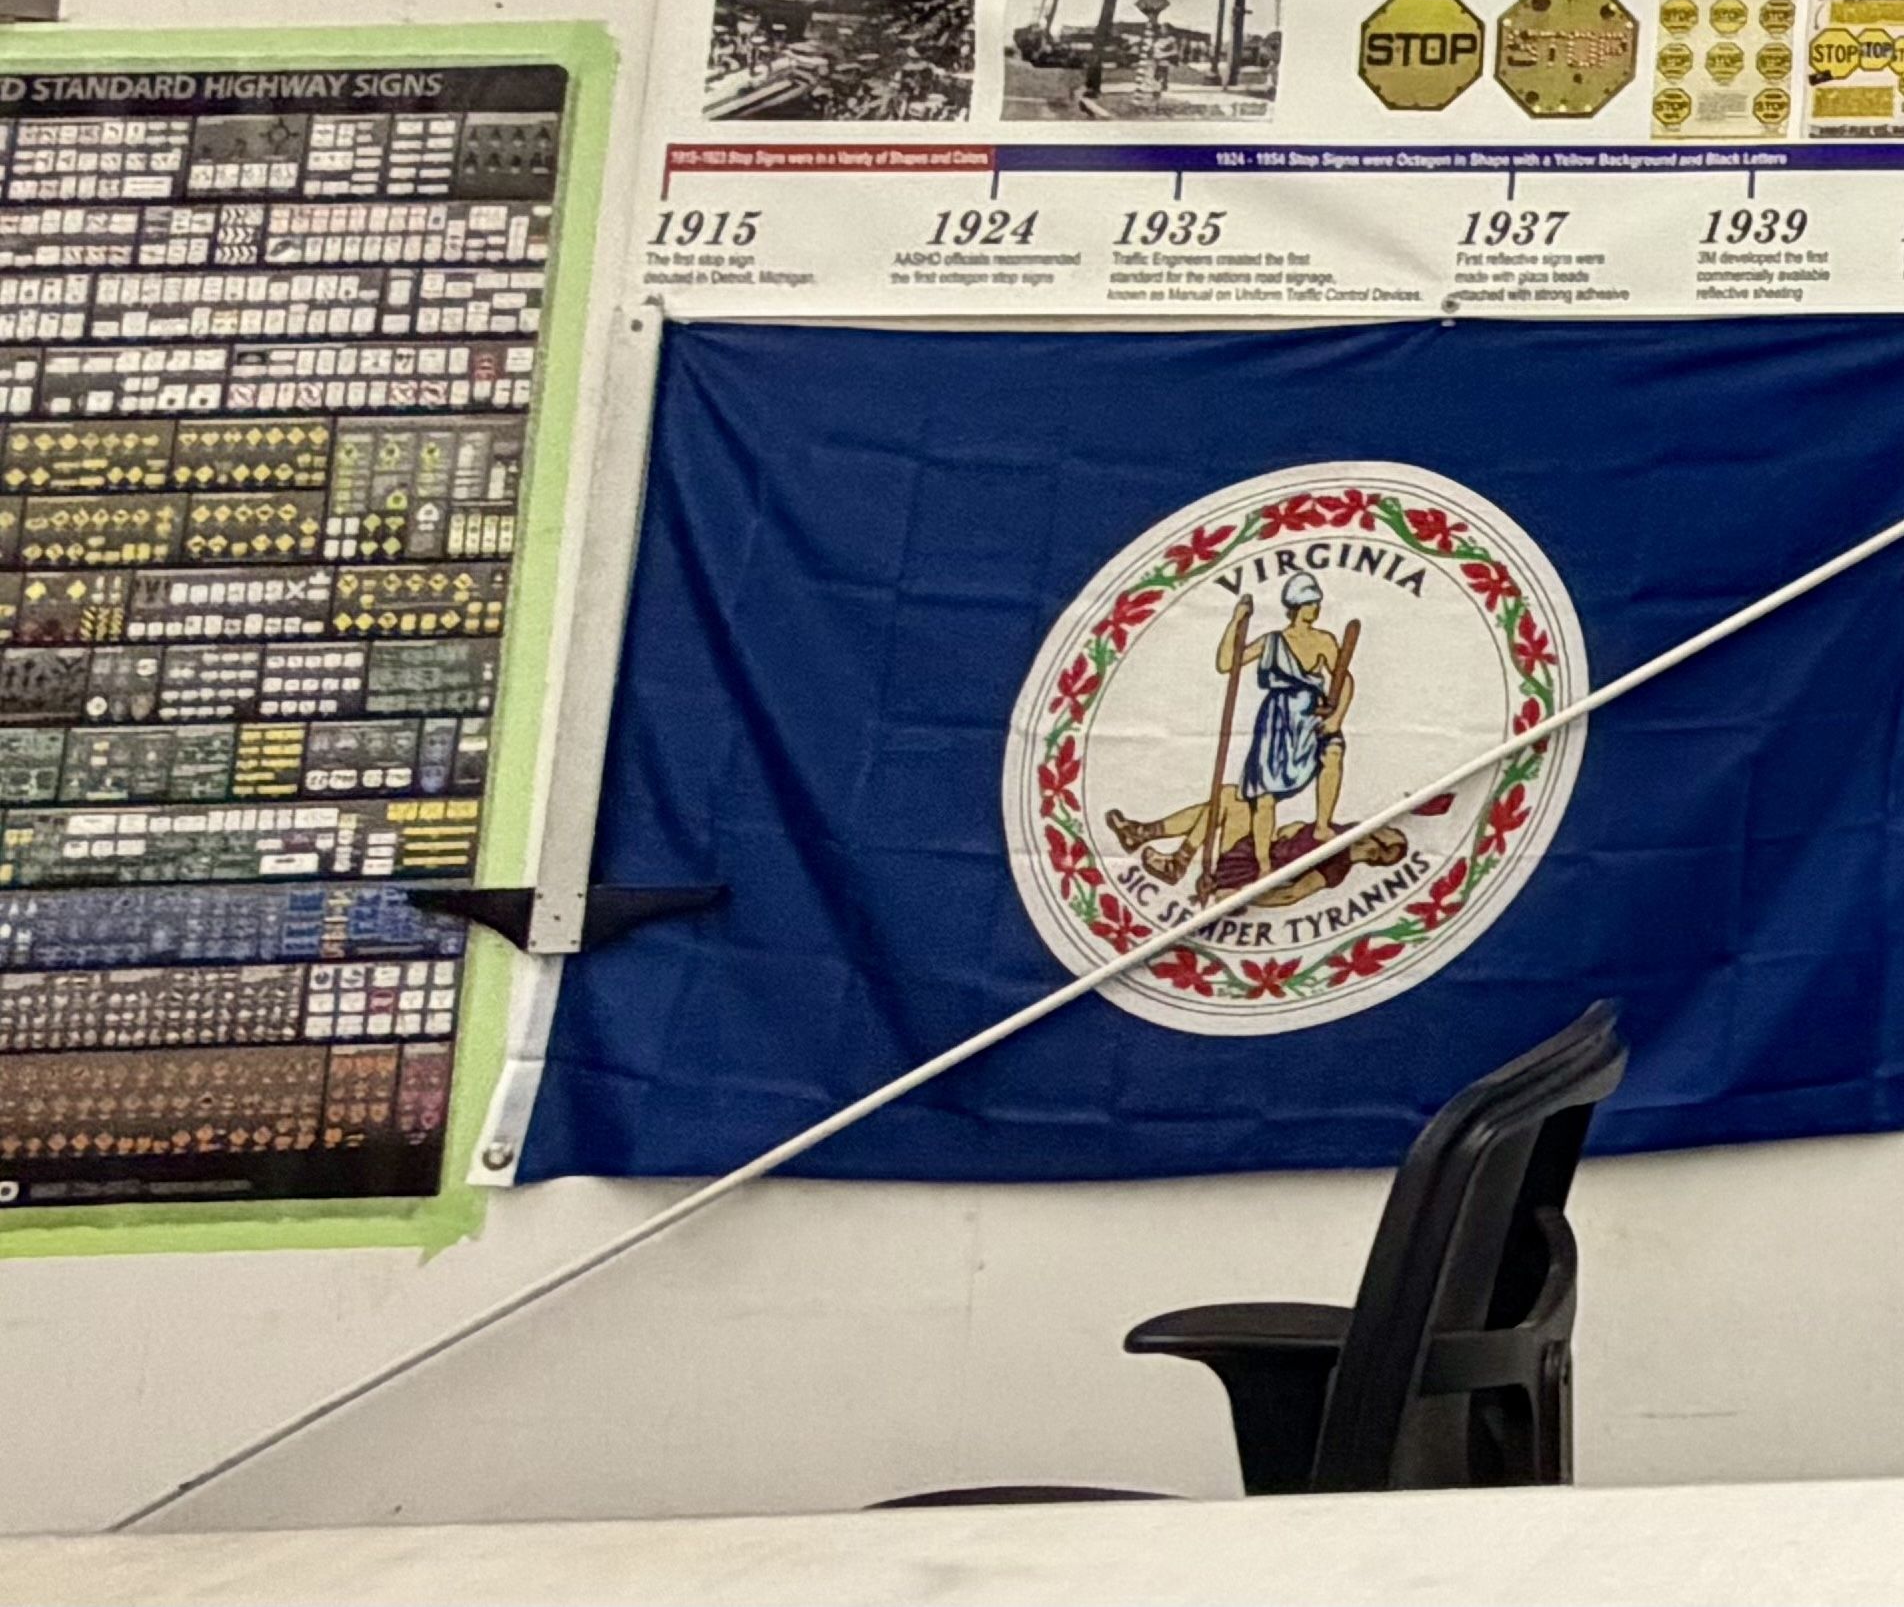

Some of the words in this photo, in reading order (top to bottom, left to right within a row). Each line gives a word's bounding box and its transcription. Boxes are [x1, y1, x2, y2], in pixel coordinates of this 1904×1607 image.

[1366, 33, 1478, 67] STOP
[1507, 30, 1628, 69] STOP
[1812, 44, 1860, 63] STOP
[33, 75, 197, 101] STANDARD
[204, 74, 350, 99] HIGHWAY
[352, 73, 443, 97] SIGNS
[647, 210, 763, 245] 1915
[926, 210, 1039, 245] 1924
[1113, 210, 1227, 245] 1935
[1458, 210, 1570, 245] 1937
[1700, 208, 1809, 244] 1939
[1213, 543, 1426, 597] VIRGINIA
[1118, 865, 1159, 906] SIC
[1284, 851, 1430, 943] TYRANNIS
